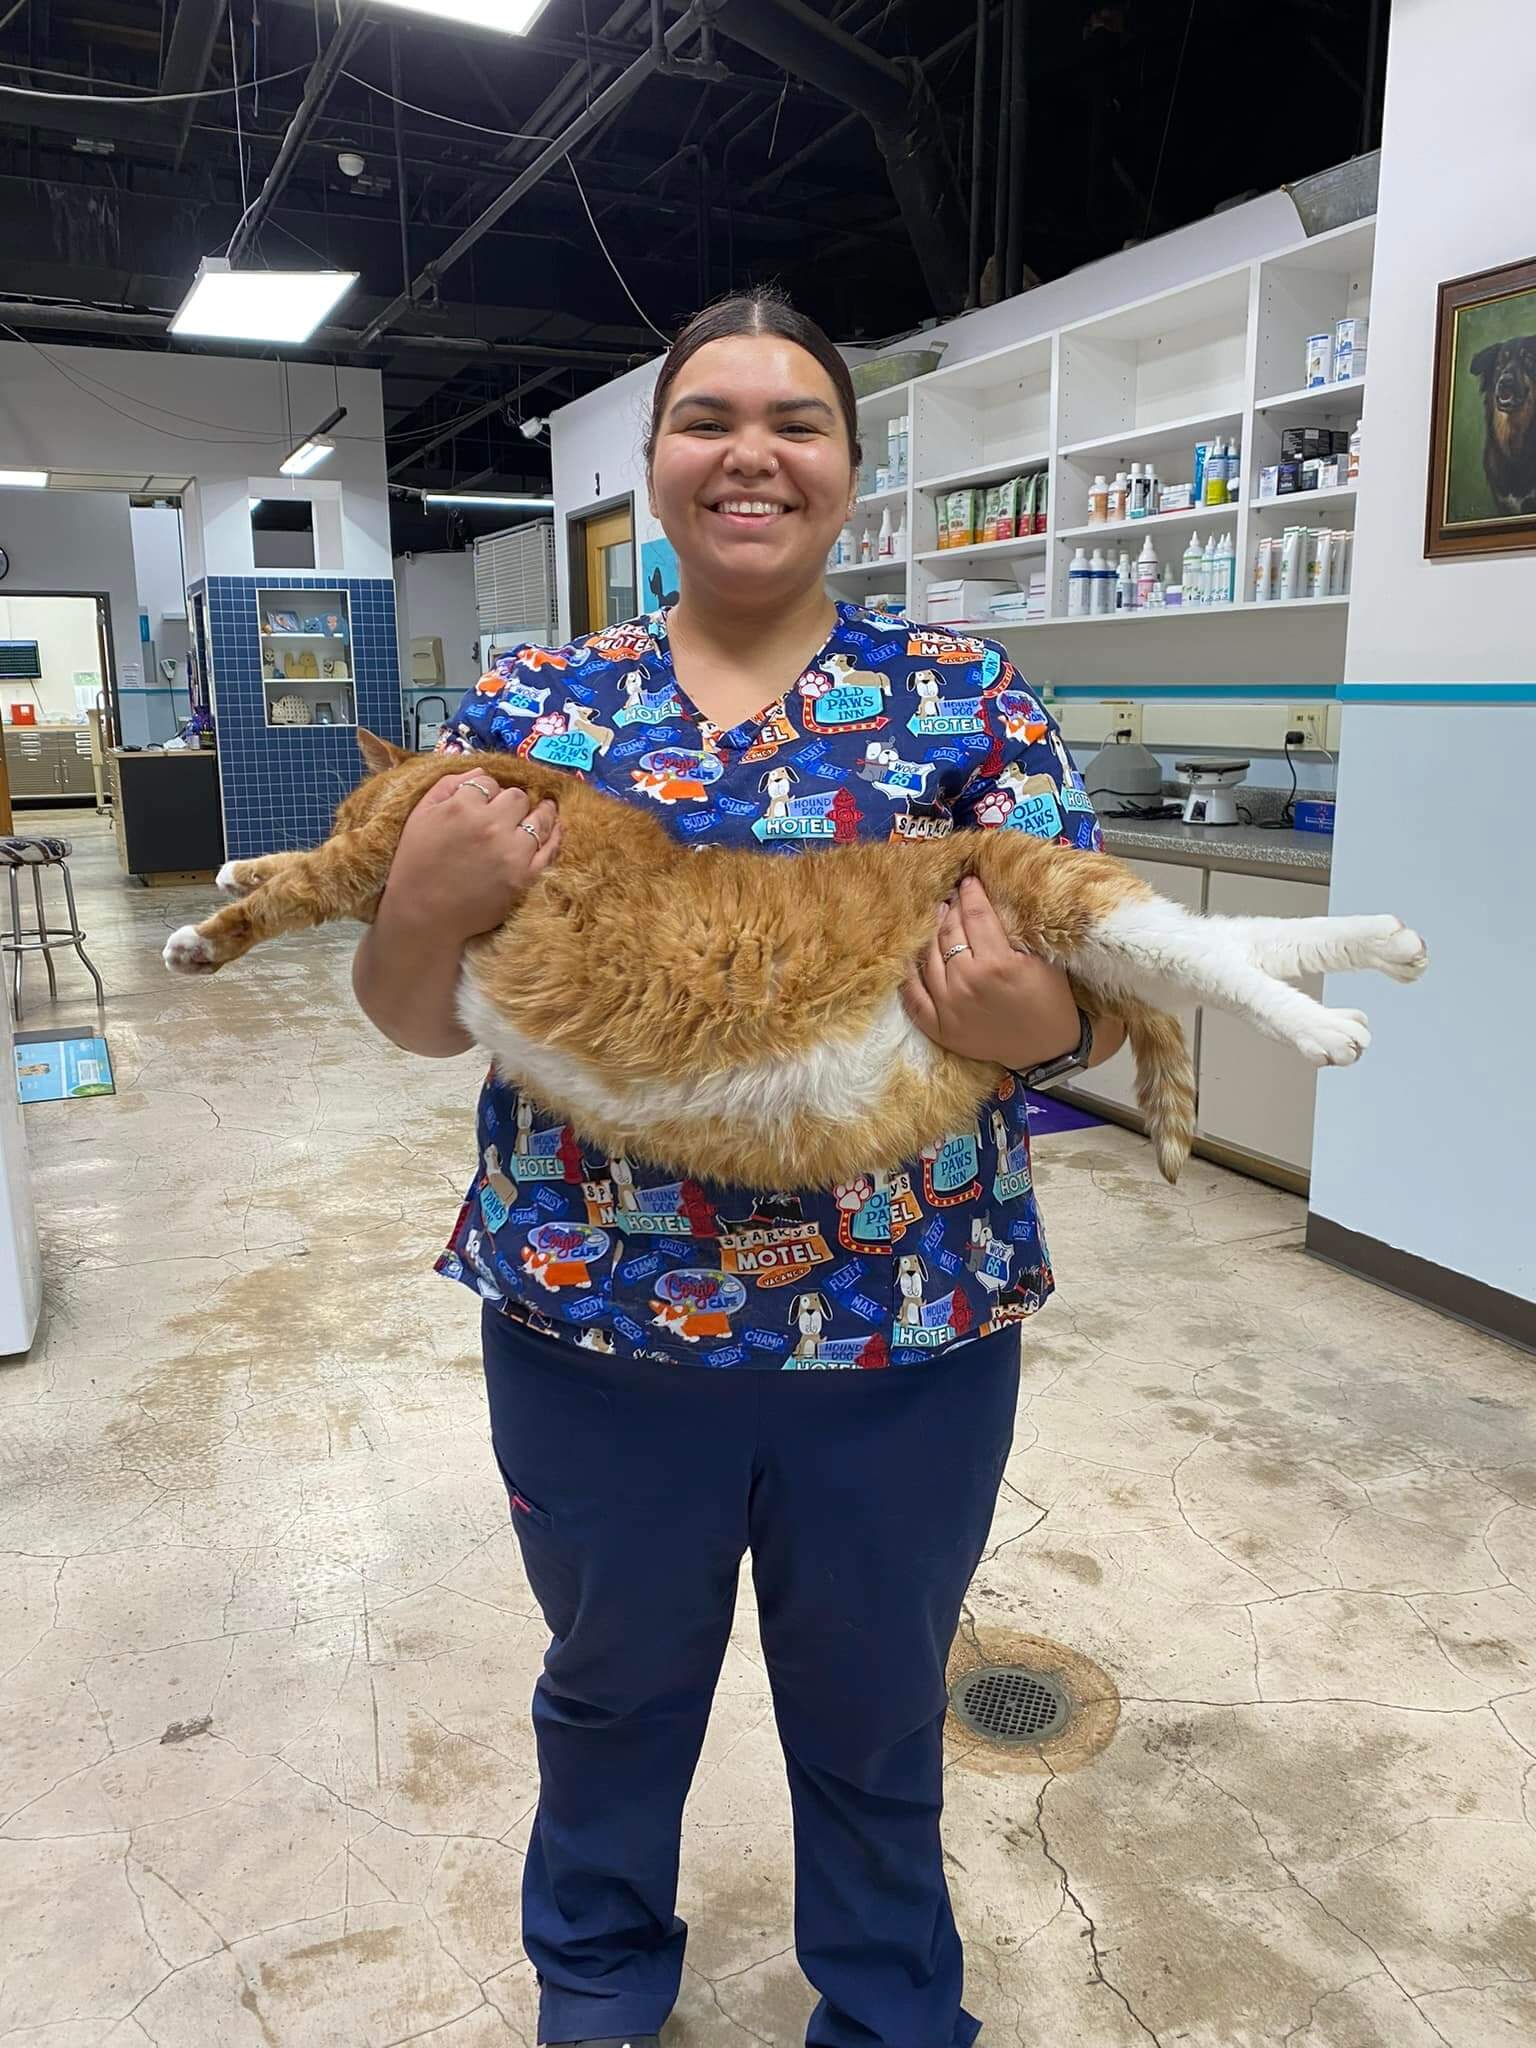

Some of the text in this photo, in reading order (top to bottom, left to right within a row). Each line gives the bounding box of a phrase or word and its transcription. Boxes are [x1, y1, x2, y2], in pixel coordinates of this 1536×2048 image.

[829, 686, 863, 699] OLD
[625, 702, 682, 721] HOTEL
[826, 696, 874, 711] PAWS
[838, 708, 864, 720] INN
[919, 718, 983, 732] HOTEL
[558, 732, 585, 748] OLD
[613, 740, 646, 757] CHAMP
[962, 738, 990, 747] COCO
[545, 738, 589, 760] PAWS
[933, 749, 963, 761] DAISY
[817, 763, 842, 778] MAX
[888, 773, 911, 787] 66
[718, 797, 755, 814] CHAMP
[794, 798, 831, 809] HOUND
[802, 807, 825, 817] DOG
[1013, 797, 1043, 820] OLD
[682, 812, 716, 830] BUDDY
[766, 819, 834, 835] HOTEL
[943, 1138, 964, 1158] OLD
[519, 1158, 564, 1176] HOTEL
[941, 1151, 972, 1176] PAWS
[947, 1170, 967, 1188] INN
[1000, 1168, 1031, 1197] HOTE
[641, 1190, 679, 1203] HOUND
[626, 1215, 691, 1232] HOTEL
[659, 1240, 691, 1257] DAISY
[736, 1242, 823, 1272] MOTEL
[623, 1256, 659, 1279] CHAMP
[940, 1252, 957, 1271] MAX
[986, 1257, 1001, 1277] 66
[764, 1268, 806, 1287] VACANCY
[569, 1297, 605, 1319] BUDDY
[852, 1295, 878, 1318] MAX
[926, 1298, 952, 1316] HOUND
[613, 1316, 643, 1339] COCO
[744, 1331, 784, 1348] CHAMP
[899, 1329, 955, 1345] HOTEL
[708, 1346, 744, 1366] BUDDY
[825, 1343, 864, 1352] HOUND
